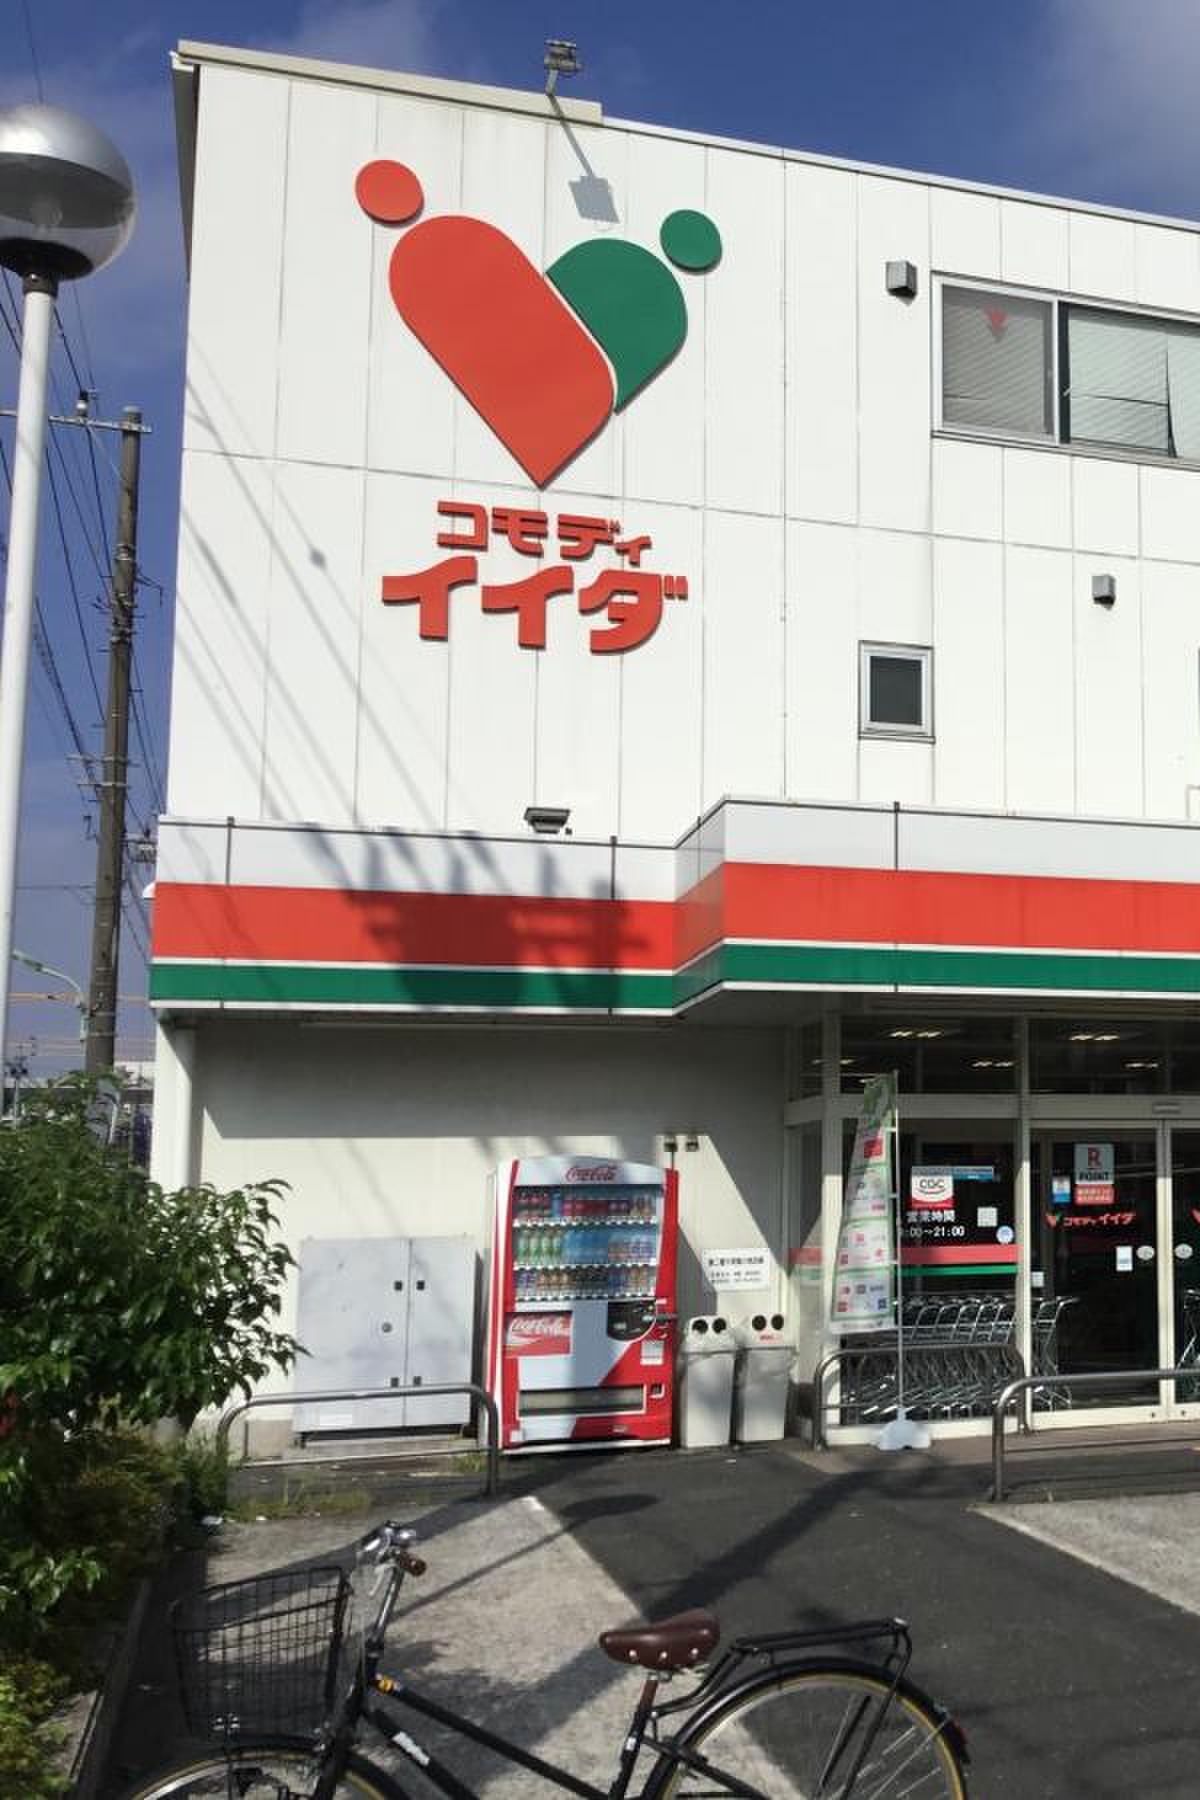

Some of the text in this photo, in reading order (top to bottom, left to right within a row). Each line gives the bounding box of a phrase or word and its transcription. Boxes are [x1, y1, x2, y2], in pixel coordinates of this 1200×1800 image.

[437, 500, 652, 567] コモディ
[381, 555, 688, 655] イイダ
